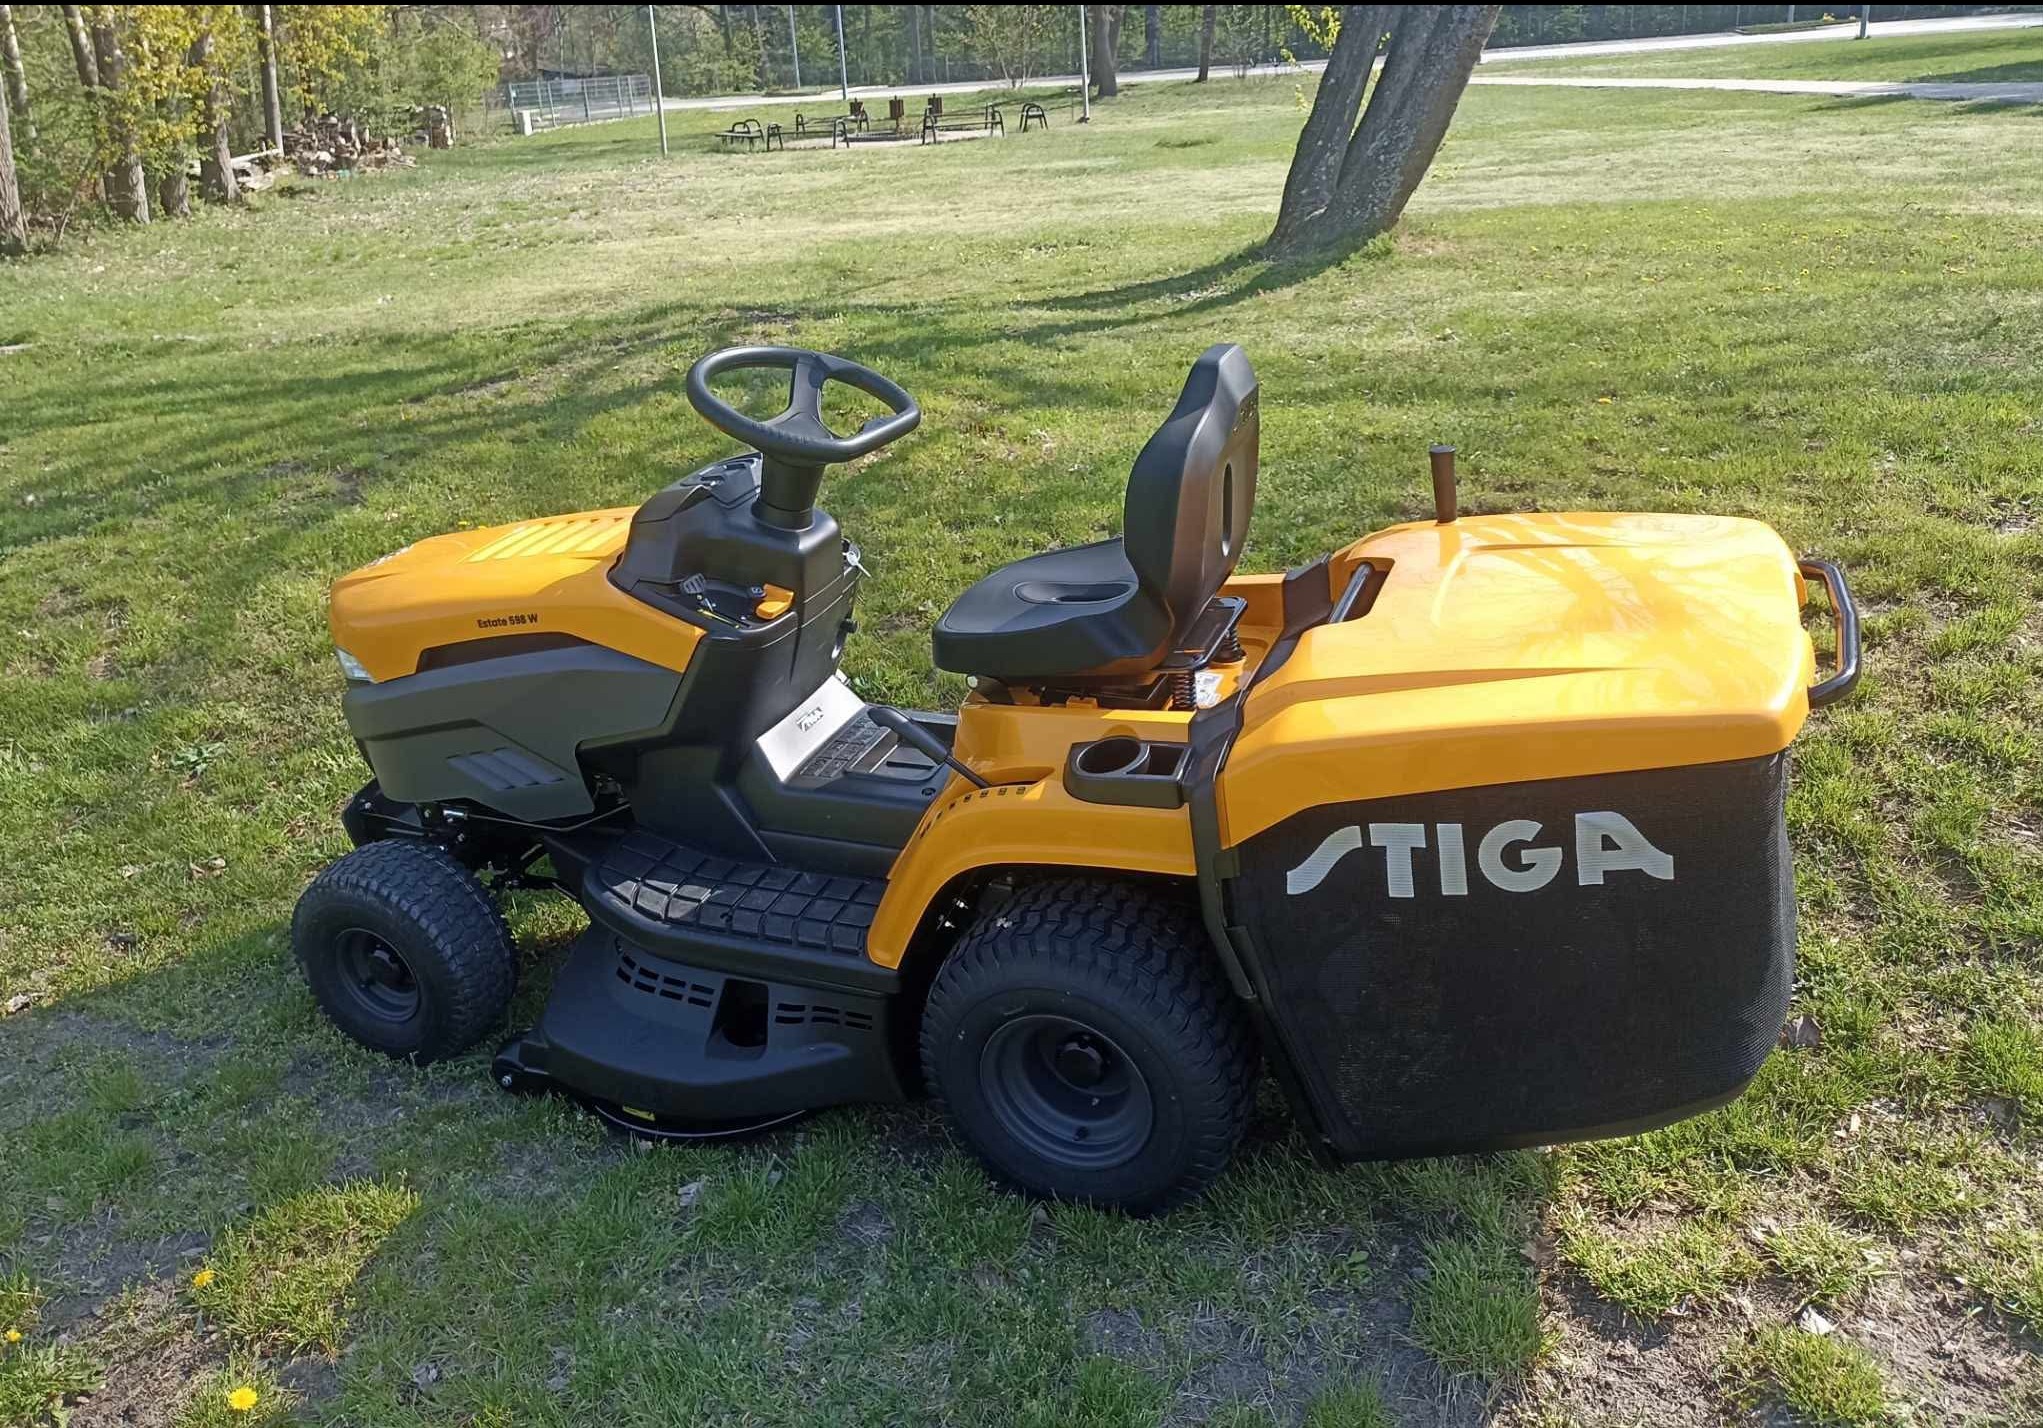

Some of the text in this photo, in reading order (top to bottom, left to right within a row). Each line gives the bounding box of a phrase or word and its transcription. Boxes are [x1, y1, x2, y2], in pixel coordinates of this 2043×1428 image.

[477, 612, 539, 629] Estate 598 W
[1286, 810, 1675, 899] STIGA
